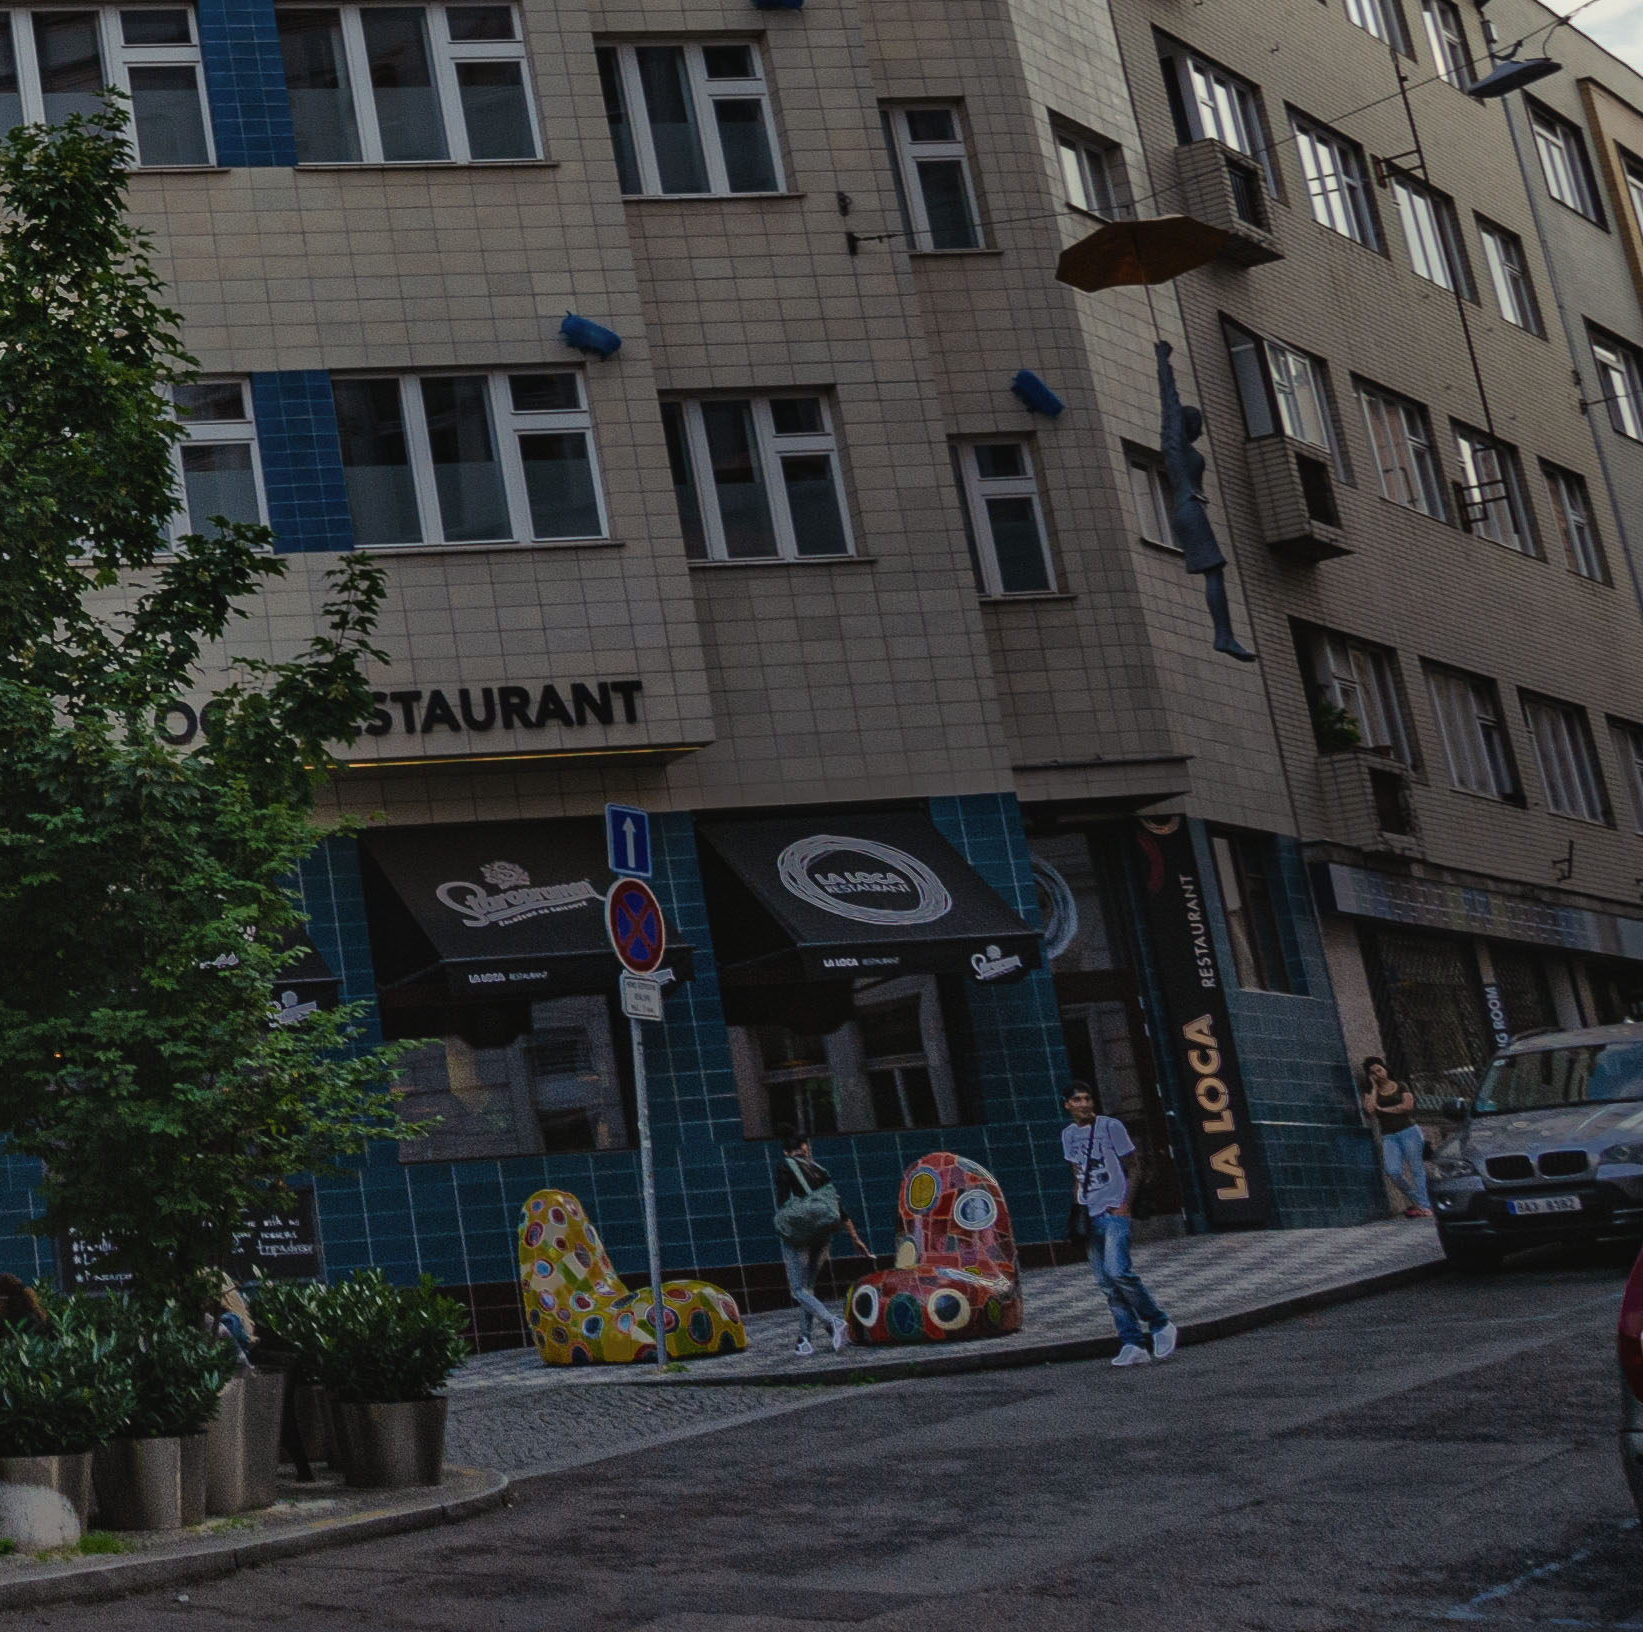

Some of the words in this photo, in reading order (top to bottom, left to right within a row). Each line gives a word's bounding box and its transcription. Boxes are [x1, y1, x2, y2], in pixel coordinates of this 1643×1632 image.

[814, 872, 846, 885] LA
[844, 871, 905, 885] LOCA
[825, 883, 912, 894] RESTAURANT
[1179, 874, 1217, 989] RESTAURANT
[1182, 1013, 1236, 1136] LOCA
[1207, 1141, 1250, 1201] LA
